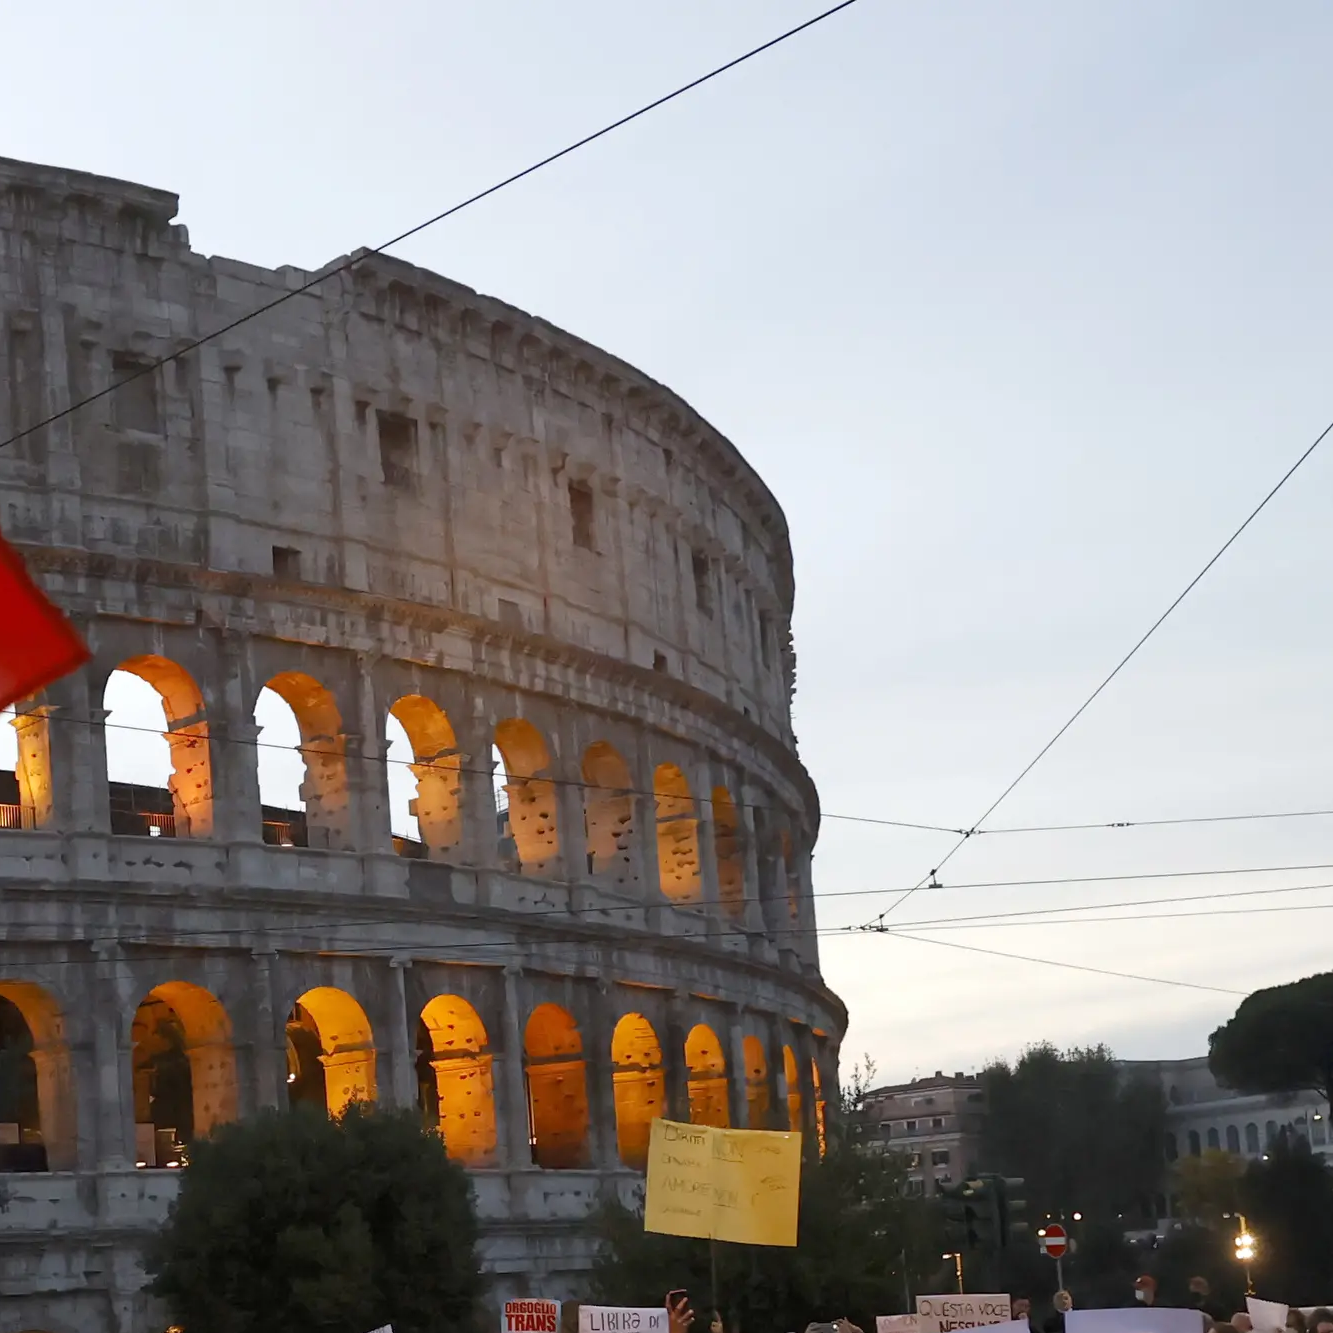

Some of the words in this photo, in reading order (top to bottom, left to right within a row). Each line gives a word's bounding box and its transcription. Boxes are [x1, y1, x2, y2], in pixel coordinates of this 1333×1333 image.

[505, 1302, 557, 1315] ORGOGLIO
[919, 1300, 974, 1318] QUESTA
[979, 1303, 1009, 1317] VOCE
[505, 1314, 556, 1332] TRANS
[649, 1315, 660, 1329] DI
